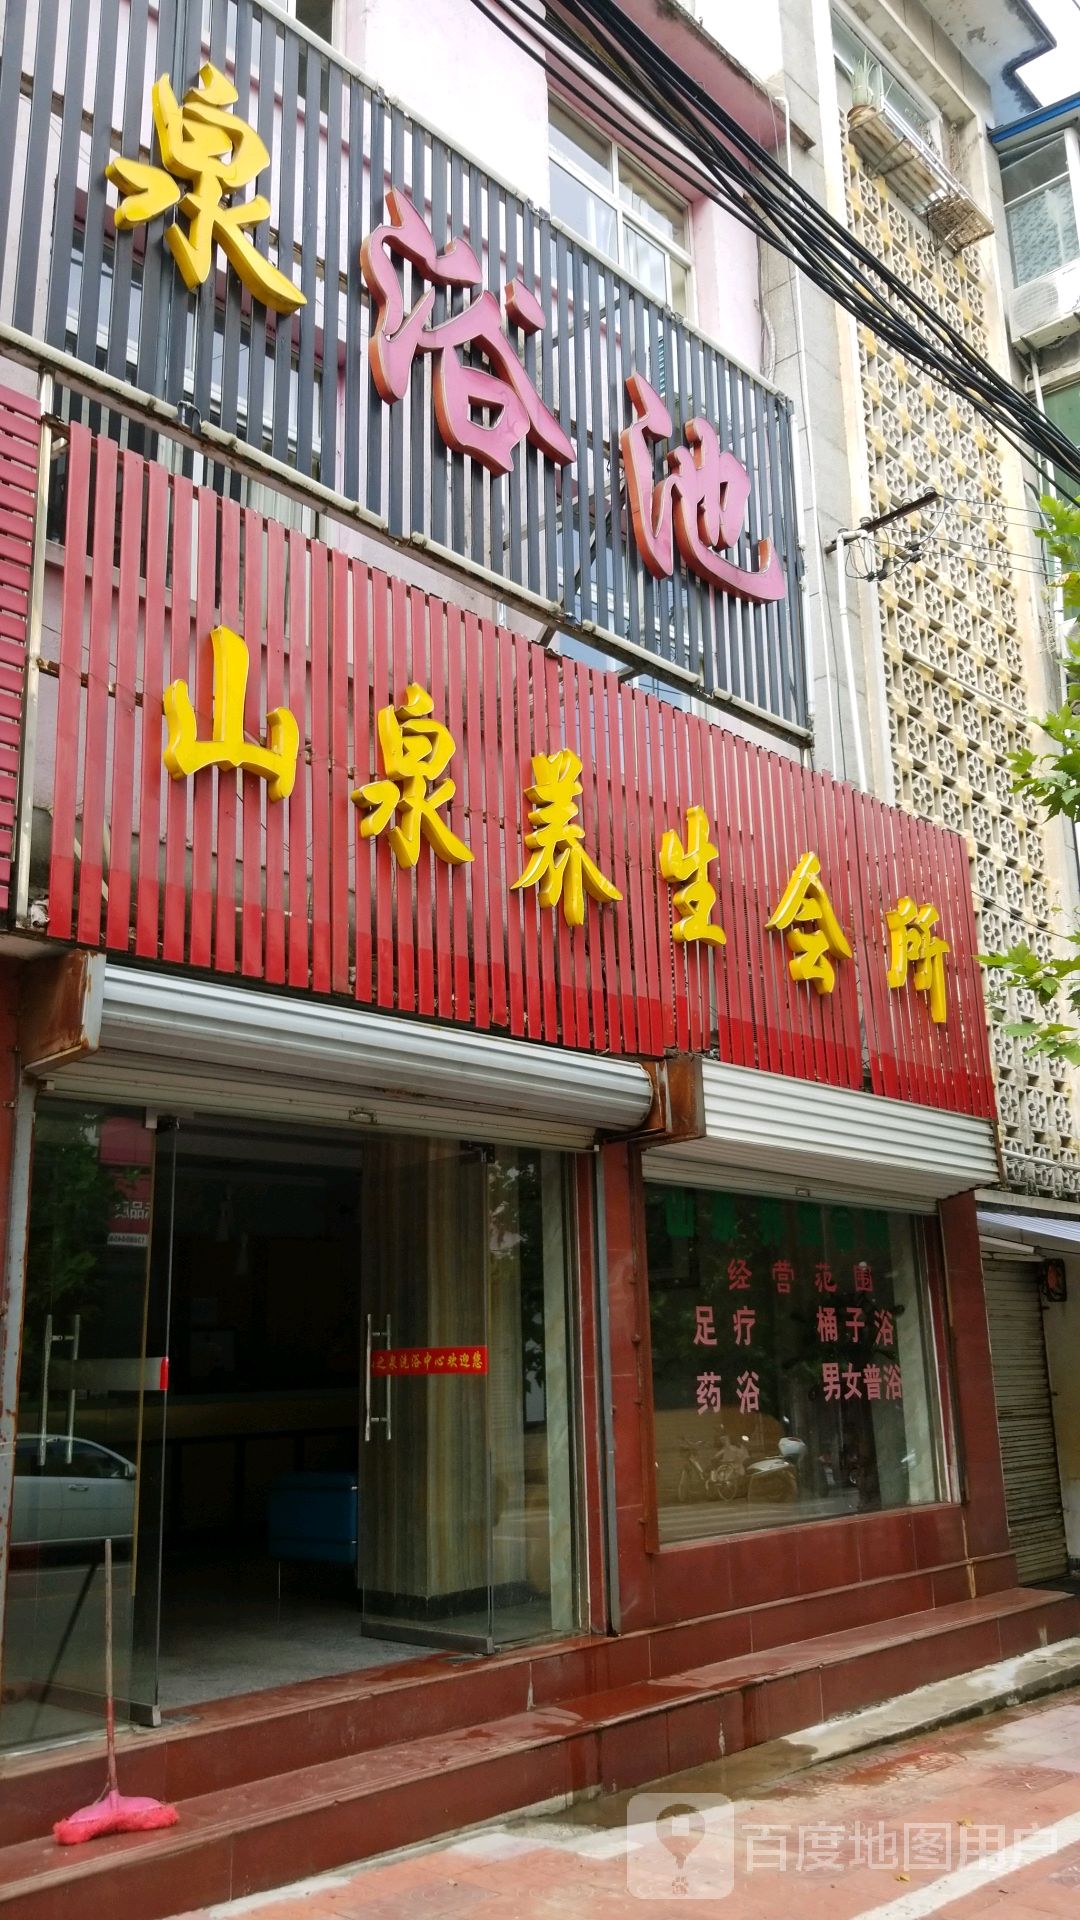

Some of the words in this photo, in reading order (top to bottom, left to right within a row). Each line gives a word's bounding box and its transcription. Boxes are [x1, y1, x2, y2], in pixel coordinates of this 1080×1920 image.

[105, 62, 786, 603] 泉浴池
[163, 626, 951, 1024] 山泉养生会所
[727, 1258, 874, 1294] 经营范围
[693, 1305, 756, 1346] 足疗
[816, 1307, 895, 1346] 桶子浴
[696, 1370, 760, 1415] 药浴
[821, 1362, 902, 1402] 男女普浴
